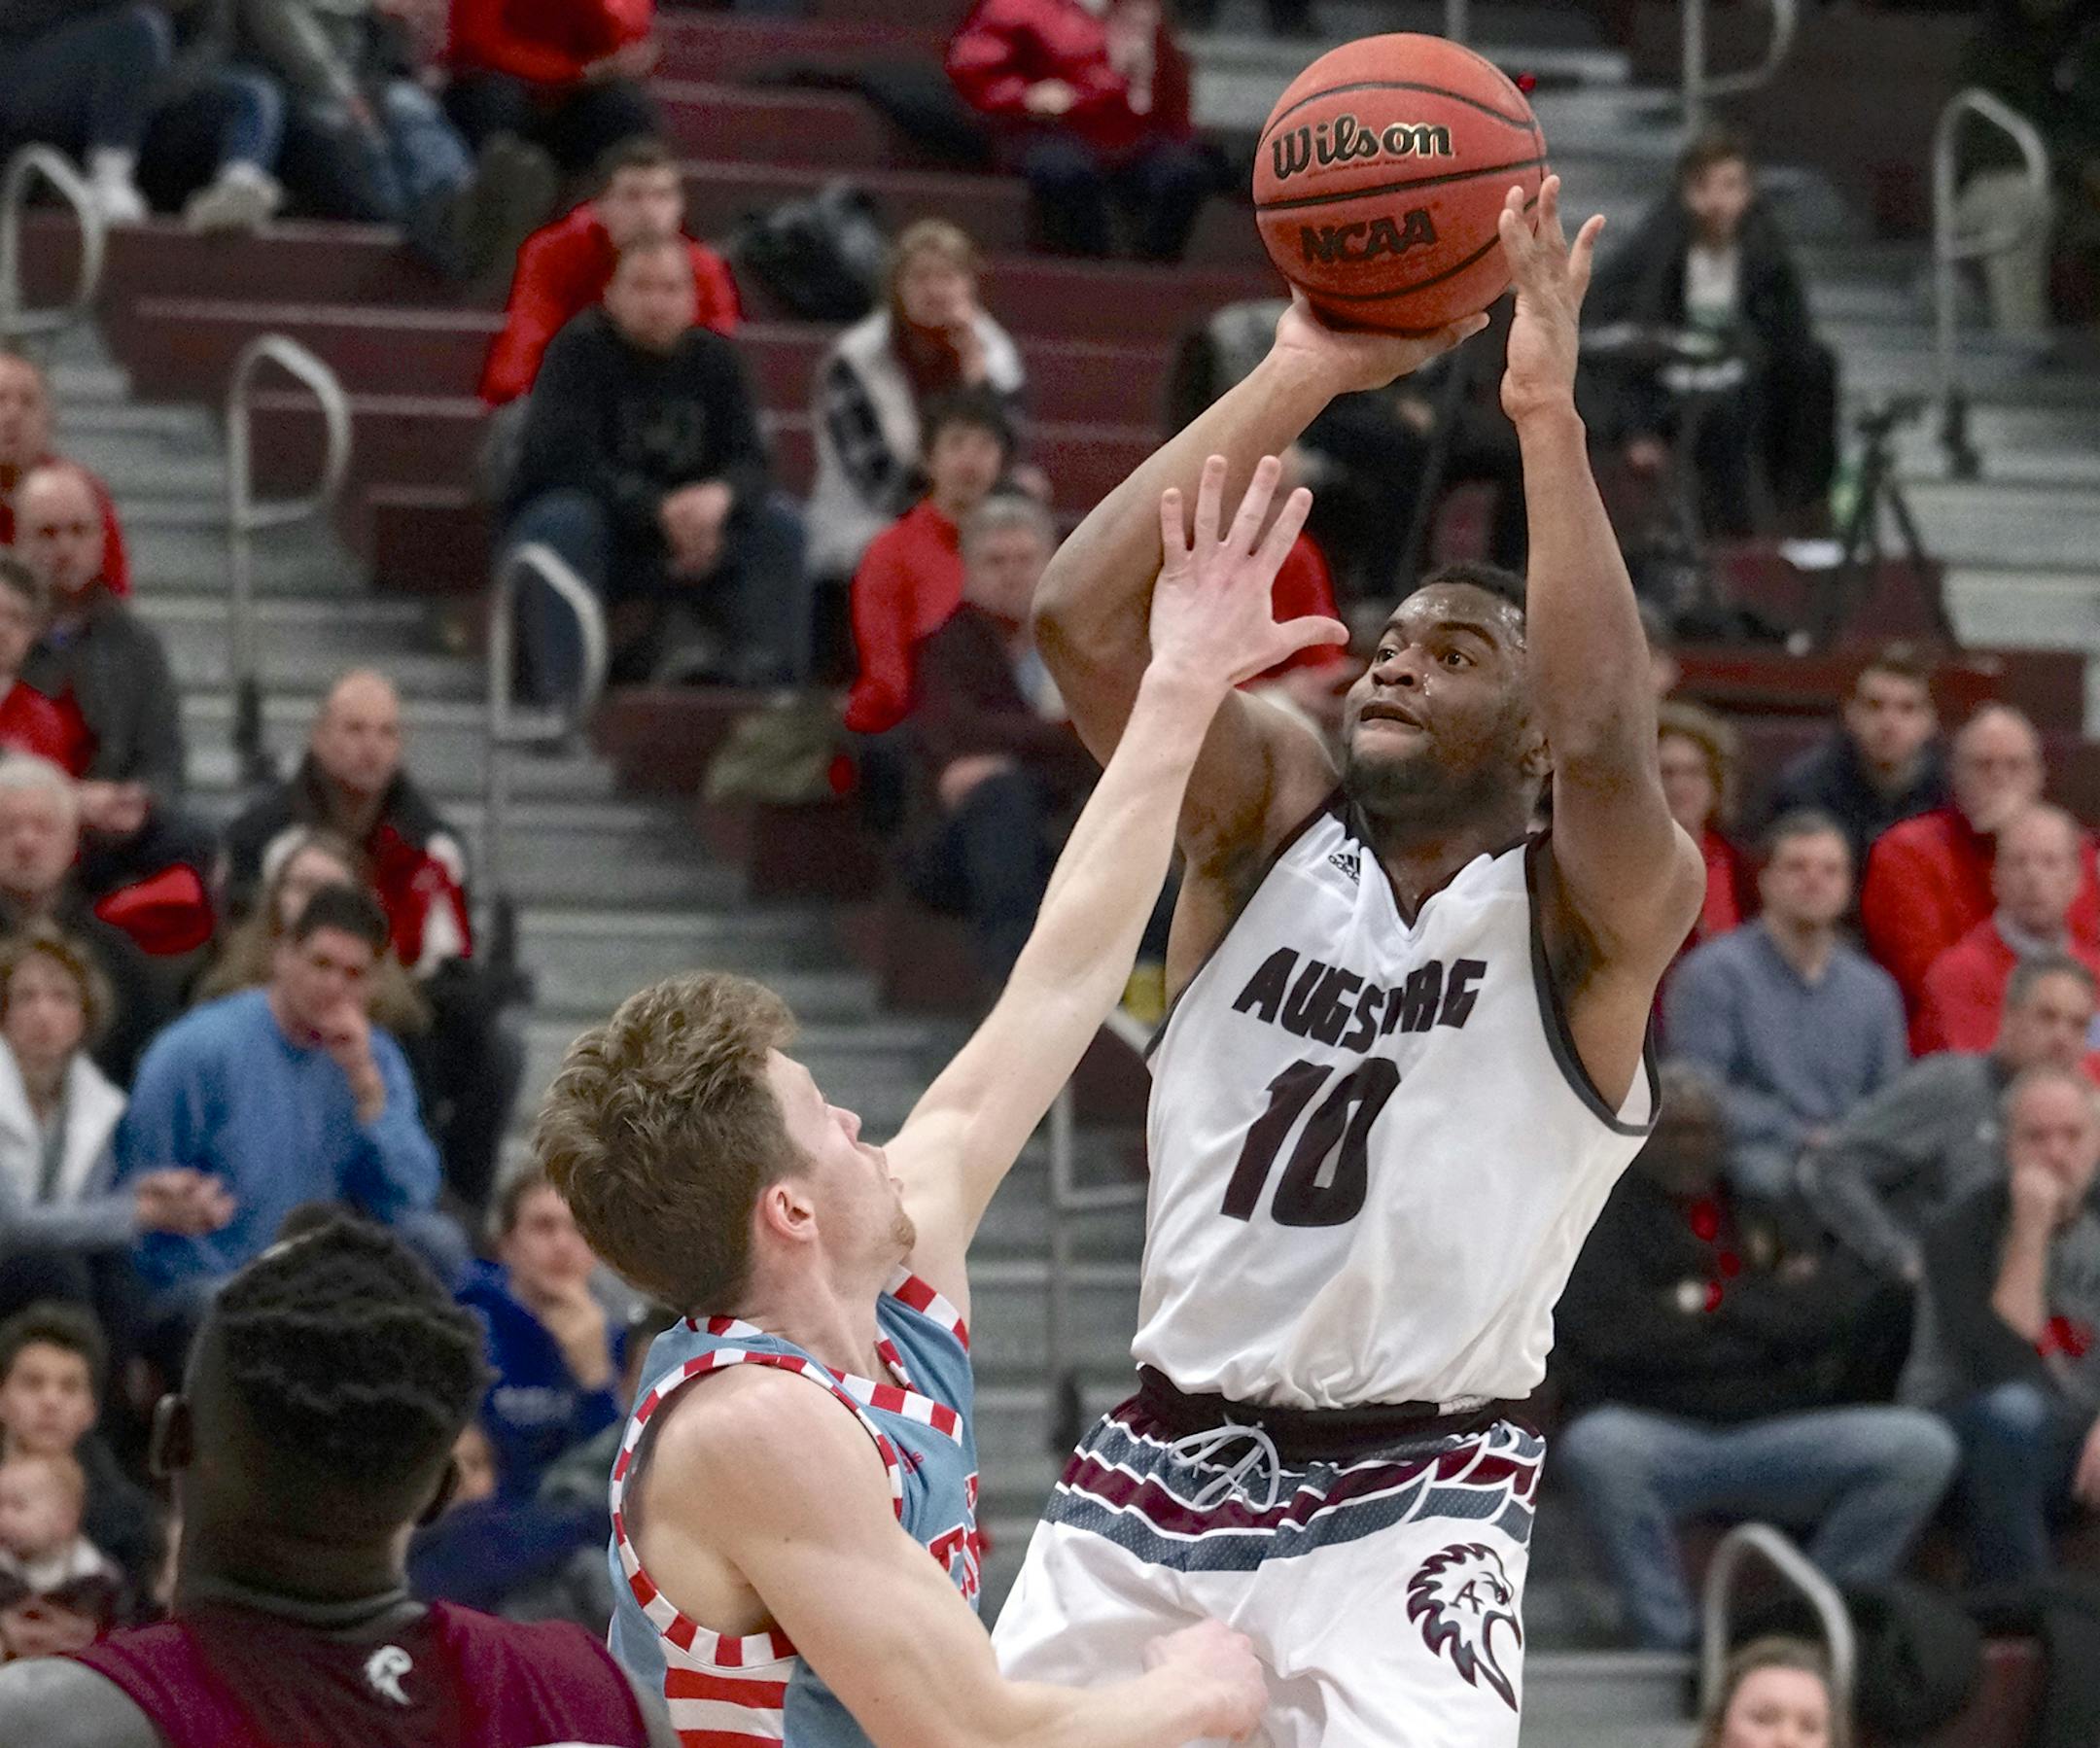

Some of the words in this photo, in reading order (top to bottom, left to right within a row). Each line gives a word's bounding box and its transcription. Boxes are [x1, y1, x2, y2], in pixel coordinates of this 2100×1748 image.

[1272, 115, 1453, 181] Wilson
[1301, 209, 1438, 262] NCAA
[1328, 855, 1360, 887] adida
[1232, 947, 1488, 1054] AUGSRG
[1219, 1057, 1402, 1227] 10
